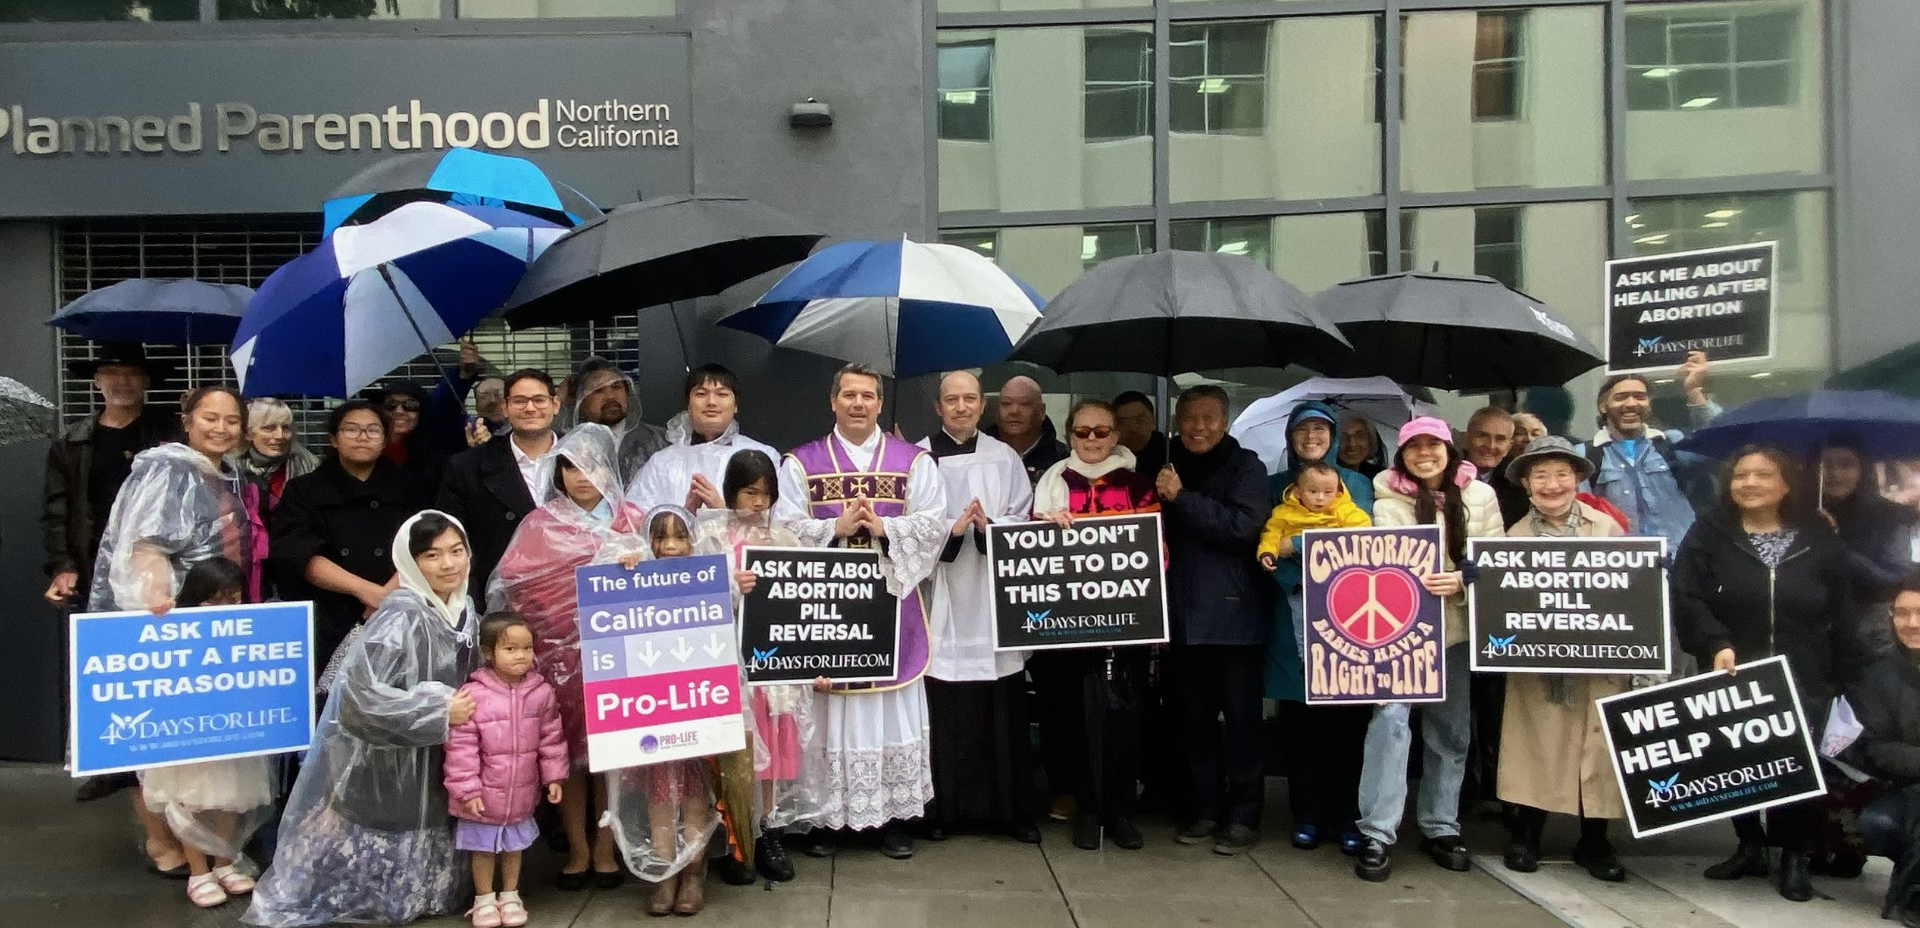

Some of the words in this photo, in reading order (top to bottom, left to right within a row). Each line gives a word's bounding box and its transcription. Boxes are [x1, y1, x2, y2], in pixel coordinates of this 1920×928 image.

[556, 98, 670, 122] Northern
[0, 101, 202, 155] lanned
[216, 98, 549, 152] Parenthood
[557, 124, 680, 148] California
[1616, 270, 1655, 288] ASK
[1660, 266, 1689, 283] ME
[1692, 258, 1762, 280] ABOUT
[1614, 285, 1699, 307] HEALING
[1703, 277, 1768, 298] AFTER
[1638, 300, 1742, 324] ABORTION
[1003, 529, 1055, 550] YOU
[1062, 524, 1139, 546] DON'T
[751, 560, 792, 578] ASK
[797, 561, 826, 579] ME
[829, 562, 883, 580] ABOU
[998, 556, 1065, 577] HAVE
[1070, 554, 1105, 573] TO
[1111, 551, 1149, 571] DO
[1309, 534, 1437, 592] CALIFORNIA
[1476, 551, 1526, 568] ASK
[1531, 551, 1566, 568] ME
[1572, 551, 1659, 568] ABOUT
[589, 576, 628, 593] The
[633, 570, 691, 589] future
[697, 565, 717, 582] of
[767, 582, 873, 600] ABORTION
[1004, 583, 1061, 604] THIS
[1066, 578, 1151, 601] TODAY
[1500, 572, 1629, 589] ABORTION
[800, 603, 842, 620] PILL
[1539, 592, 1591, 610] PILL
[590, 600, 724, 633] California
[1505, 612, 1634, 631] REVERSAL
[138, 621, 202, 643] ASK
[211, 618, 254, 638] ME
[769, 623, 874, 641] REVERSAL
[1312, 618, 1370, 664] BABIES
[1374, 631, 1423, 663] HAVE
[1416, 621, 1434, 637] A
[82, 649, 193, 675] ABOUT
[201, 647, 222, 666] A
[231, 641, 303, 663] FREE
[592, 649, 616, 672] is
[1311, 642, 1376, 696] RIGHT
[1377, 673, 1391, 689] TO
[1391, 640, 1439, 695] LIFE
[91, 667, 297, 702] ULTRASOUND
[597, 680, 730, 721] Pro-Life
[1621, 701, 1680, 736] WE
[1684, 680, 1775, 720] WILL
[659, 730, 698, 746] PRO-LIFE
[1620, 731, 1711, 775] HELP
[1718, 710, 1797, 750] YOU
